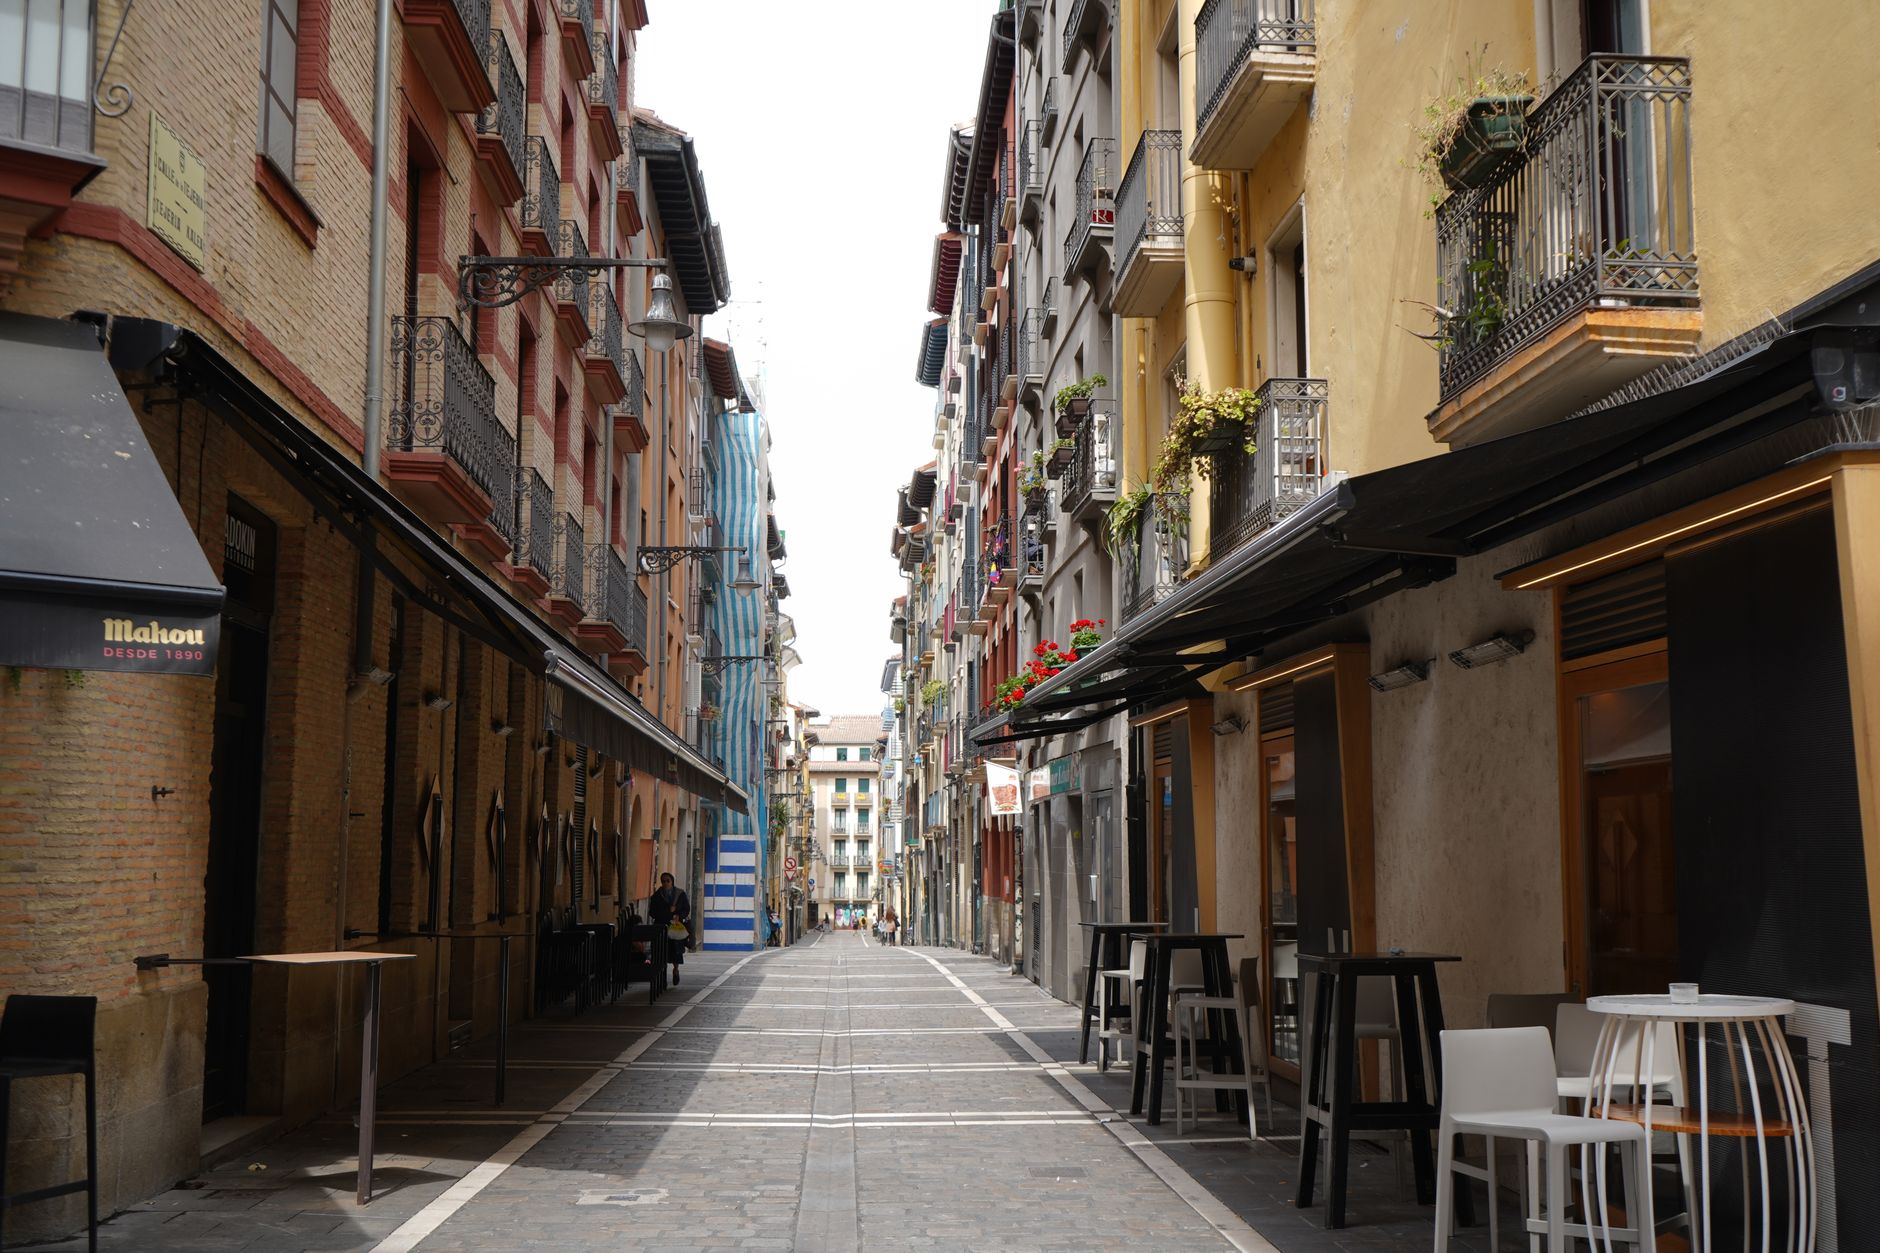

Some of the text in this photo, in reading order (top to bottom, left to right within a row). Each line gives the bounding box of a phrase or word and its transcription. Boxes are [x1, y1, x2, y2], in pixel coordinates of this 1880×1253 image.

[158, 157, 175, 185] CALLE
[103, 618, 206, 645] Mahou
[103, 647, 204, 660] DESDE 1890
